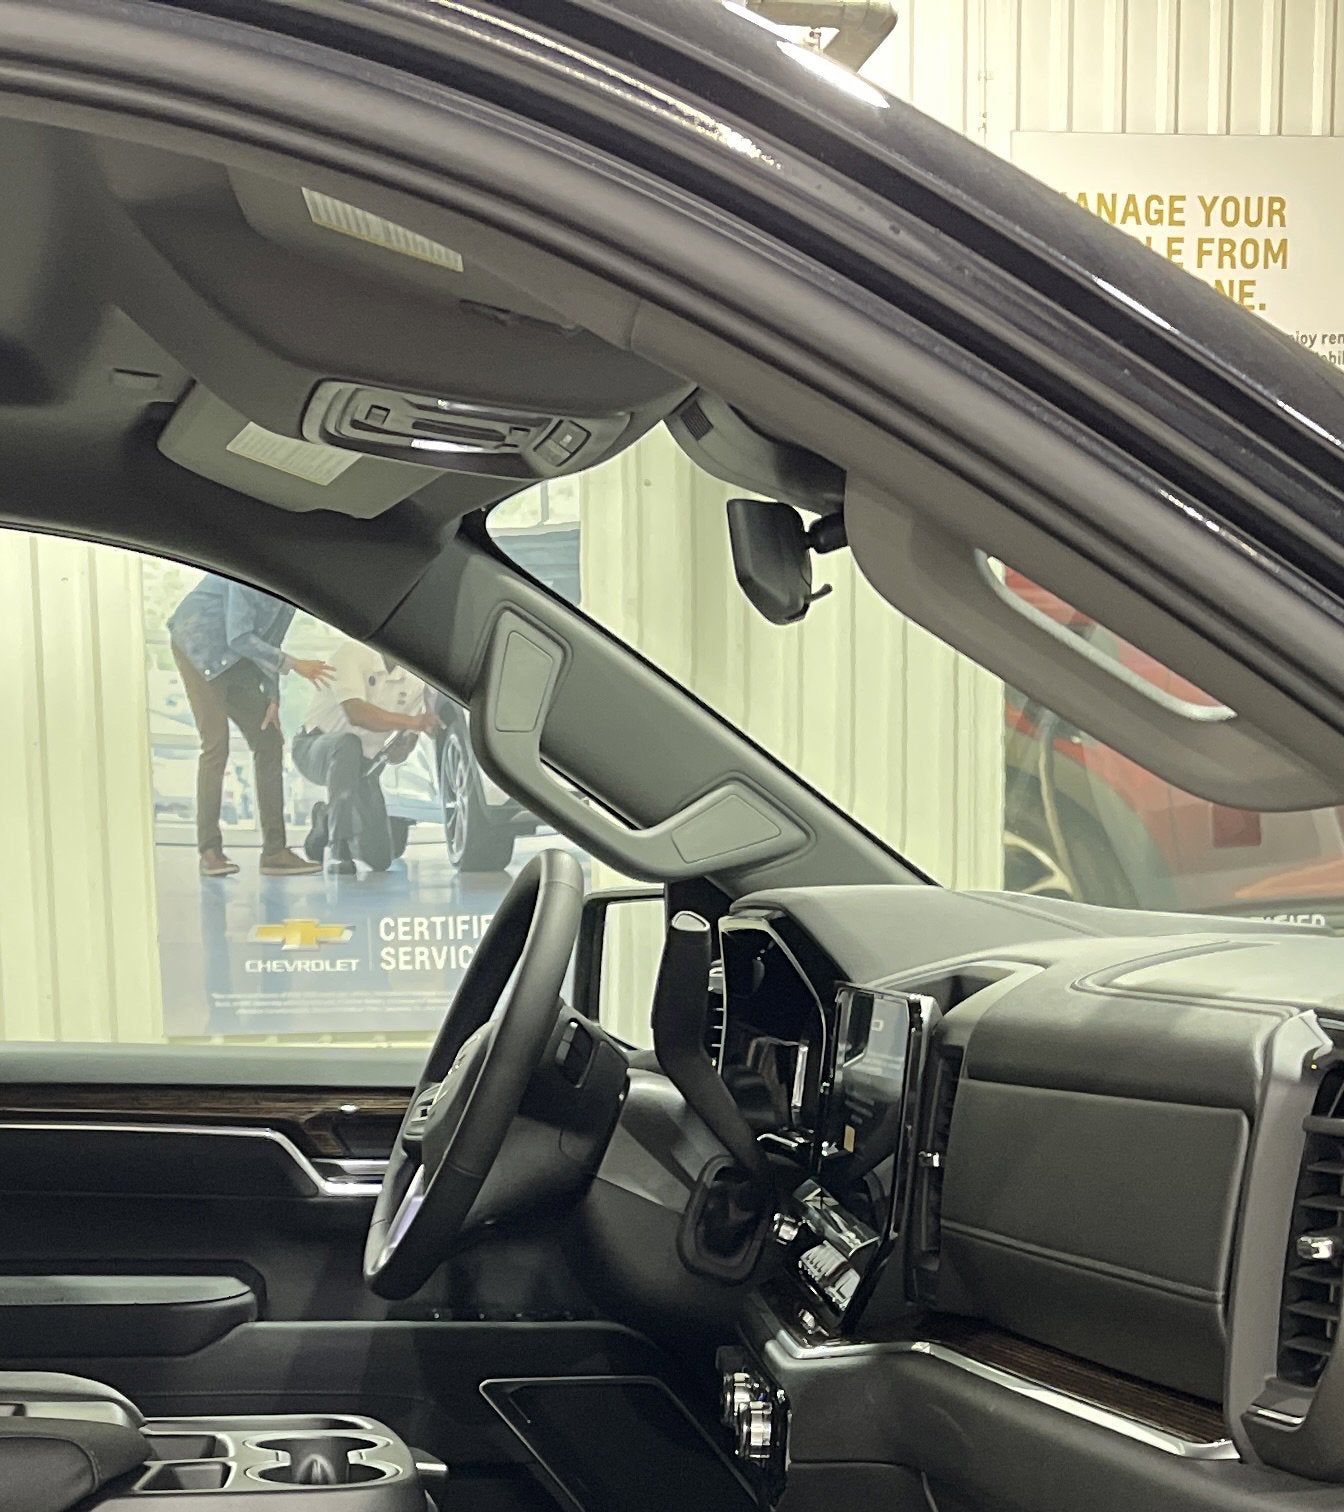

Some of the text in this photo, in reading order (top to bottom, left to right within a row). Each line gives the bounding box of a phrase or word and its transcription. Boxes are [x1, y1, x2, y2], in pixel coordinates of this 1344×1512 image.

[1060, 192, 1287, 228] ANAGE YOUR
[1197, 238, 1288, 270] FROM
[1290, 330, 1317, 348] joy
[245, 958, 360, 973] CHEVROLET
[380, 945, 476, 971] SERVIC
